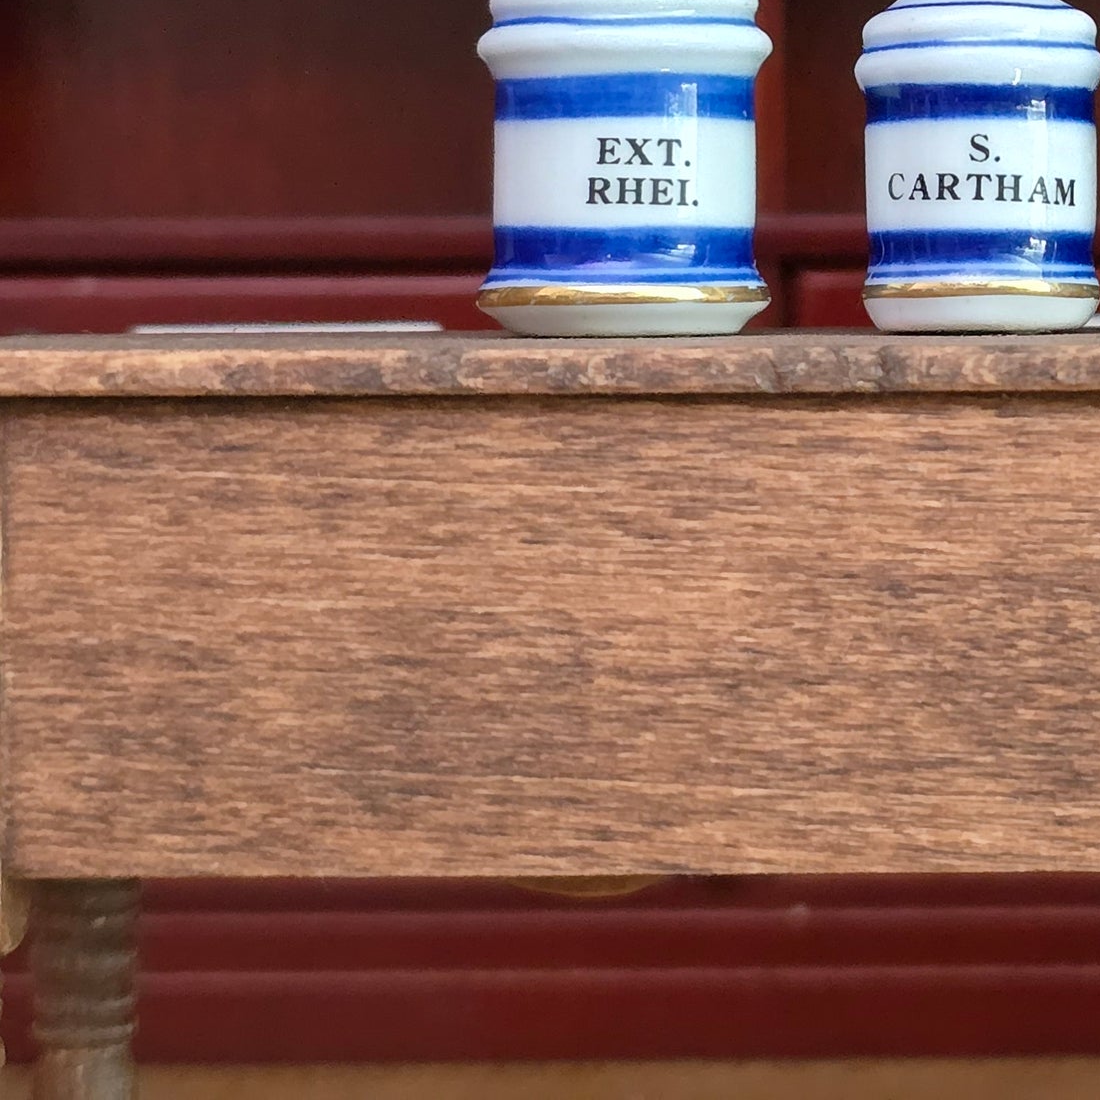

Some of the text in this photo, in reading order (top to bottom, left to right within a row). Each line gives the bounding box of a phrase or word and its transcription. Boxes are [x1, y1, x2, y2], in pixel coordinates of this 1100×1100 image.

[596, 137, 691, 167] EXT.
[969, 133, 1001, 163] S.
[585, 177, 698, 207] RHEI.
[888, 172, 1076, 207] CARTHAM
